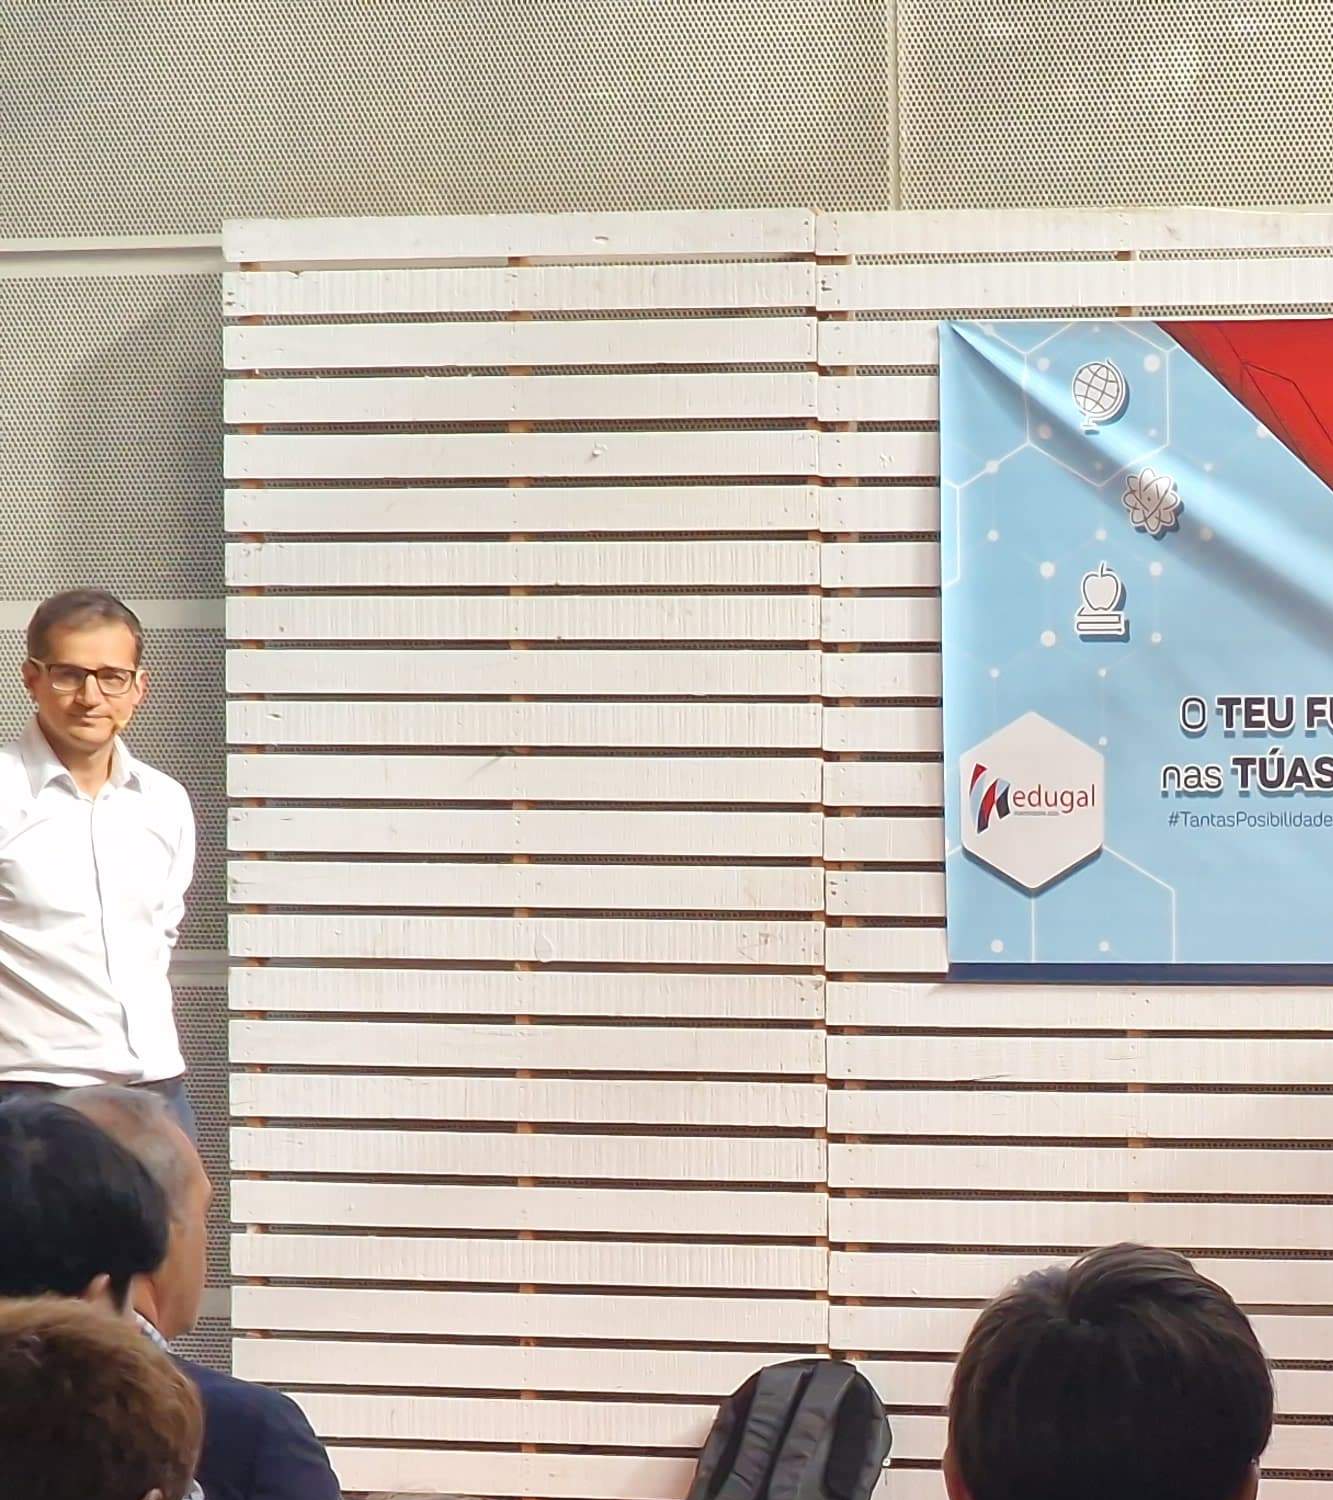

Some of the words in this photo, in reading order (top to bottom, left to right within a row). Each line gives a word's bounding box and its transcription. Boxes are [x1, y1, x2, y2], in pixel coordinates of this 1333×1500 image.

[1180, 696, 1207, 731] O
[1216, 695, 1296, 731] TEU
[1162, 764, 1223, 791] nas
[1013, 784, 1095, 813] edugal
